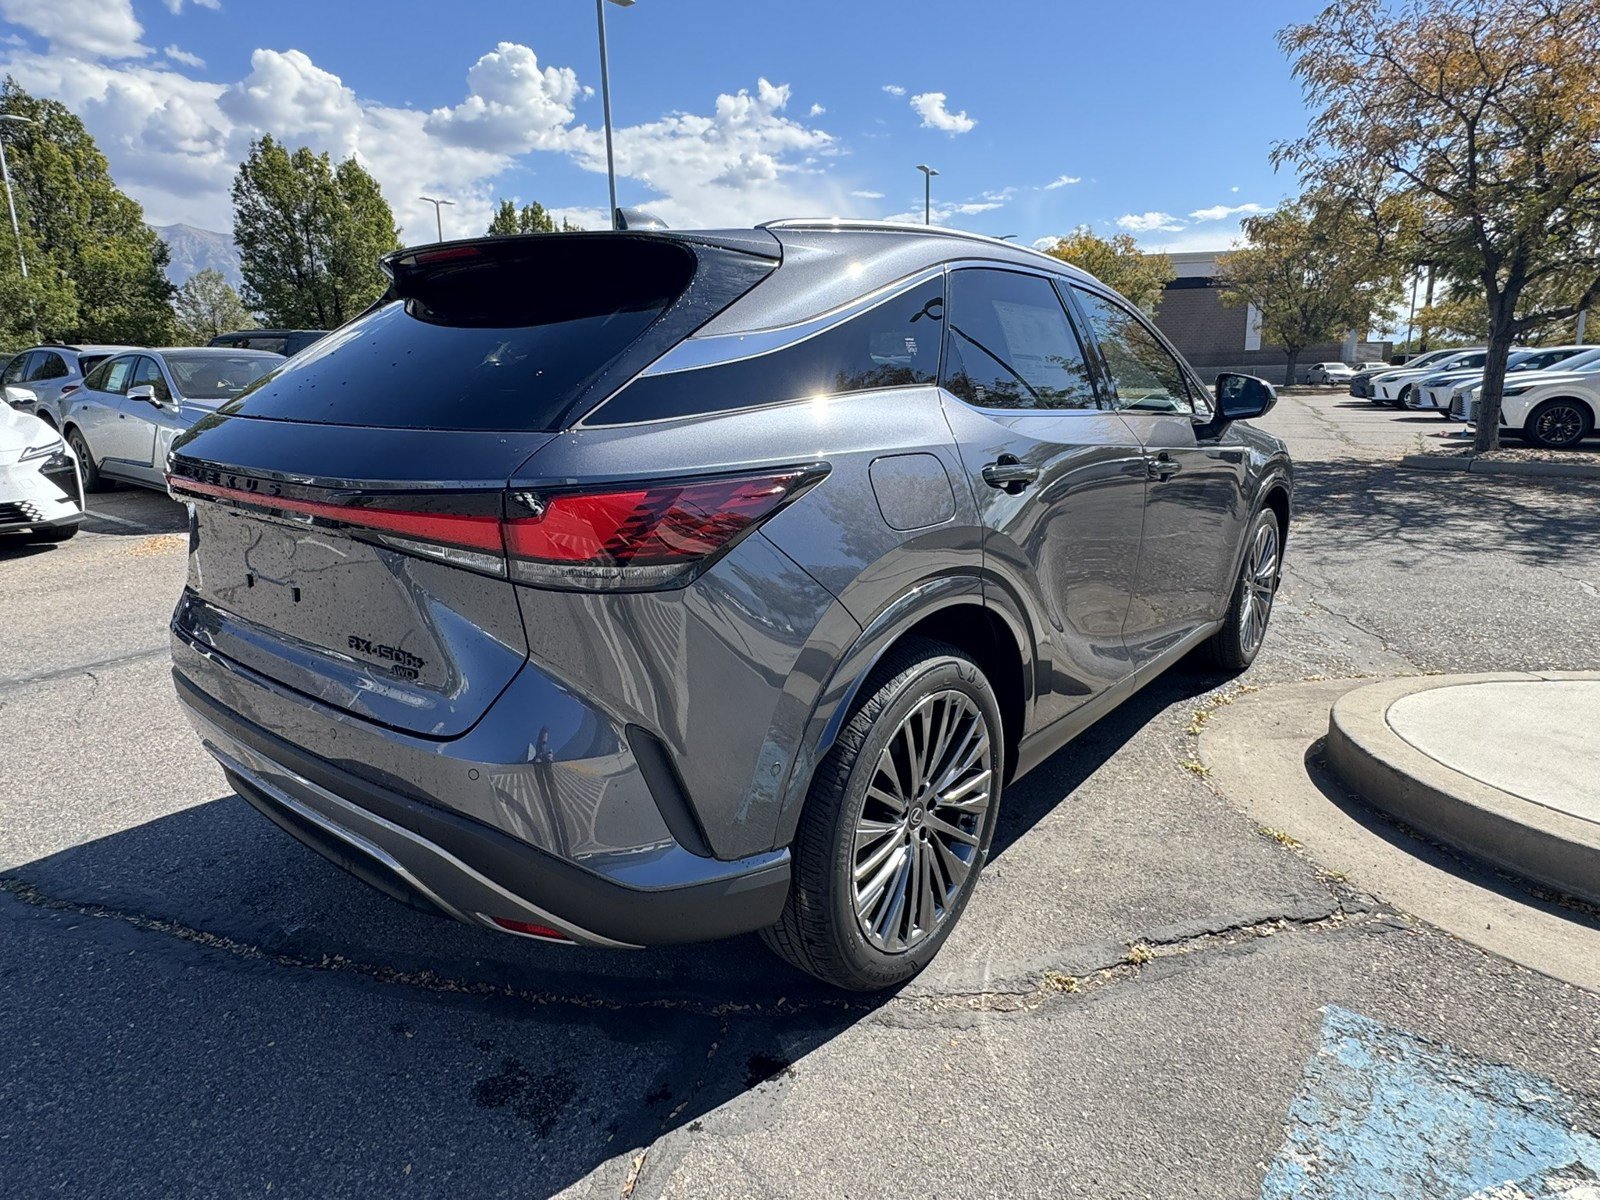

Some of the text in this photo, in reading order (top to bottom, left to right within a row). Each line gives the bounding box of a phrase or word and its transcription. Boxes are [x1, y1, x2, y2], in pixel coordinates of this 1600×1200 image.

[348, 635, 425, 668] RX 450h+
[390, 664, 419, 680] AWD
